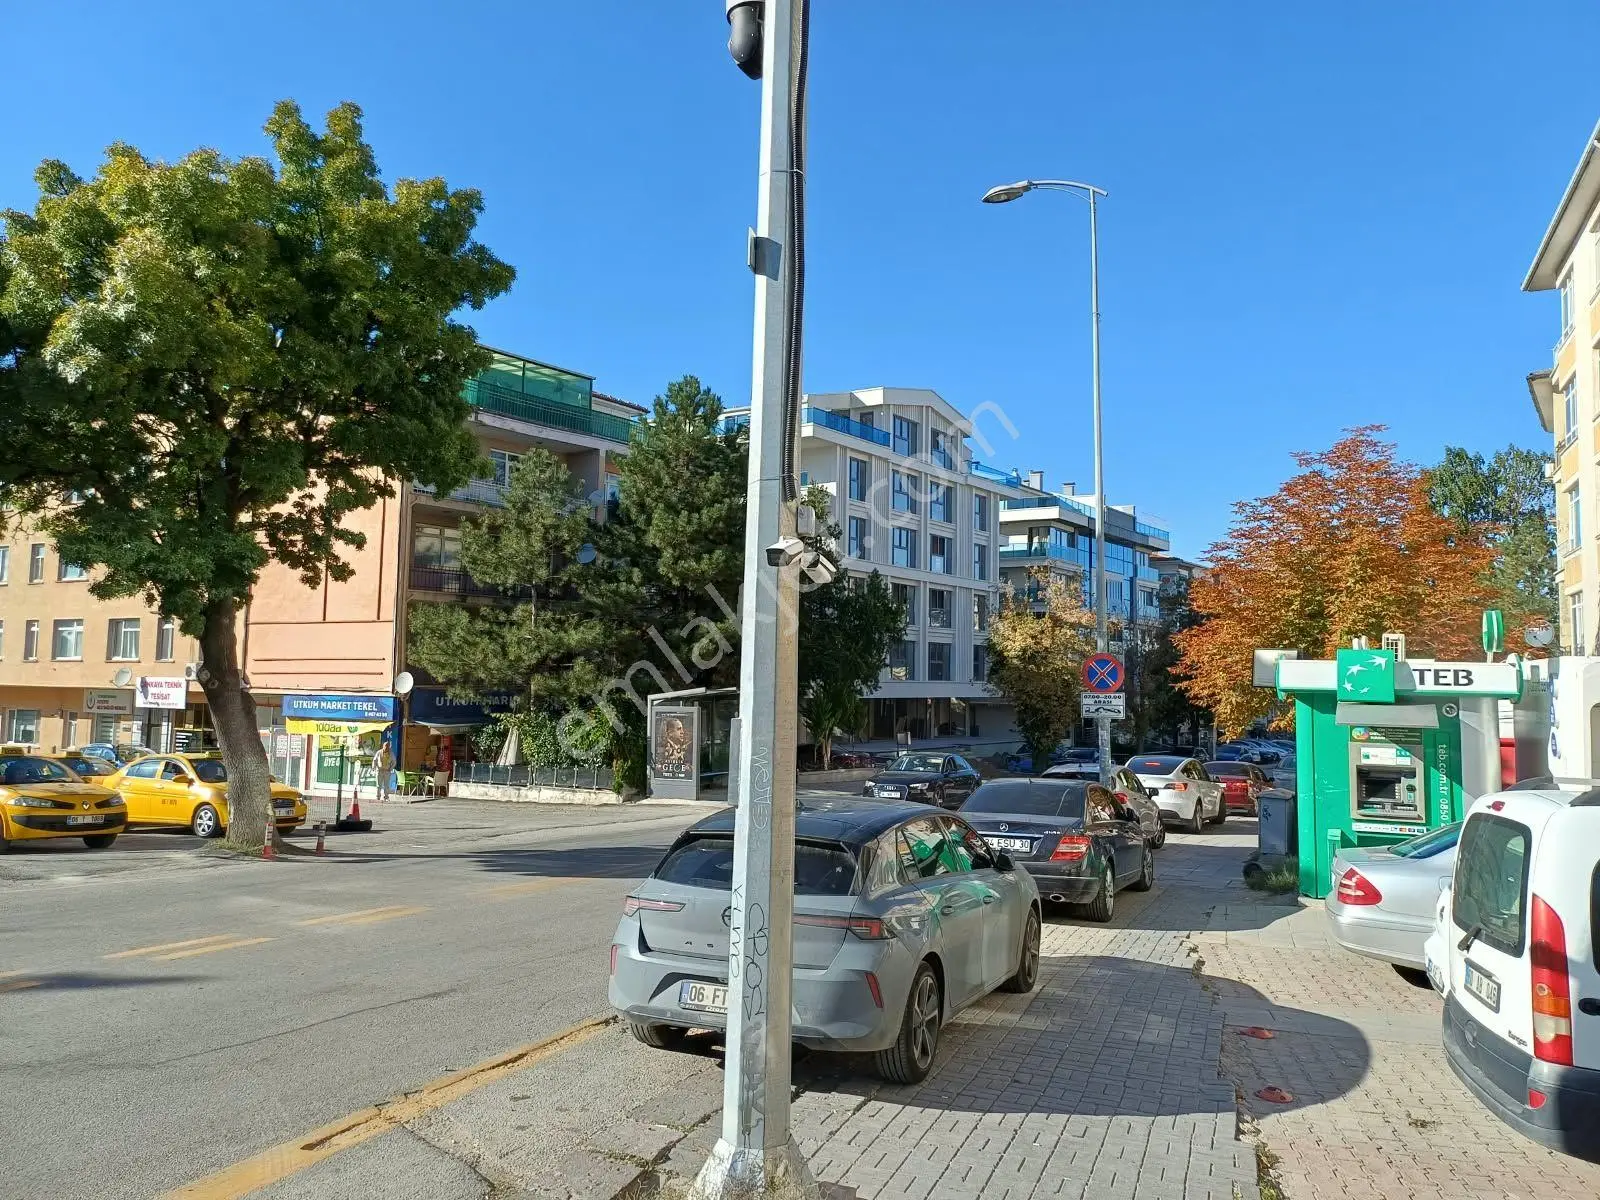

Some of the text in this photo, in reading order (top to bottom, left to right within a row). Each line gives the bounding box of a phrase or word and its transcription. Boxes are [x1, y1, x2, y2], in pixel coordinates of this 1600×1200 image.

[1412, 668, 1475, 687] TEB
[293, 700, 378, 711] UTKUM MARKET TEKEL
[1438, 744, 1449, 795] teb.com.tr
[1440, 798, 1449, 820] 0850
[997, 838, 1015, 849] ESU
[1019, 840, 1029, 849] 30
[689, 985, 706, 1003] 06
